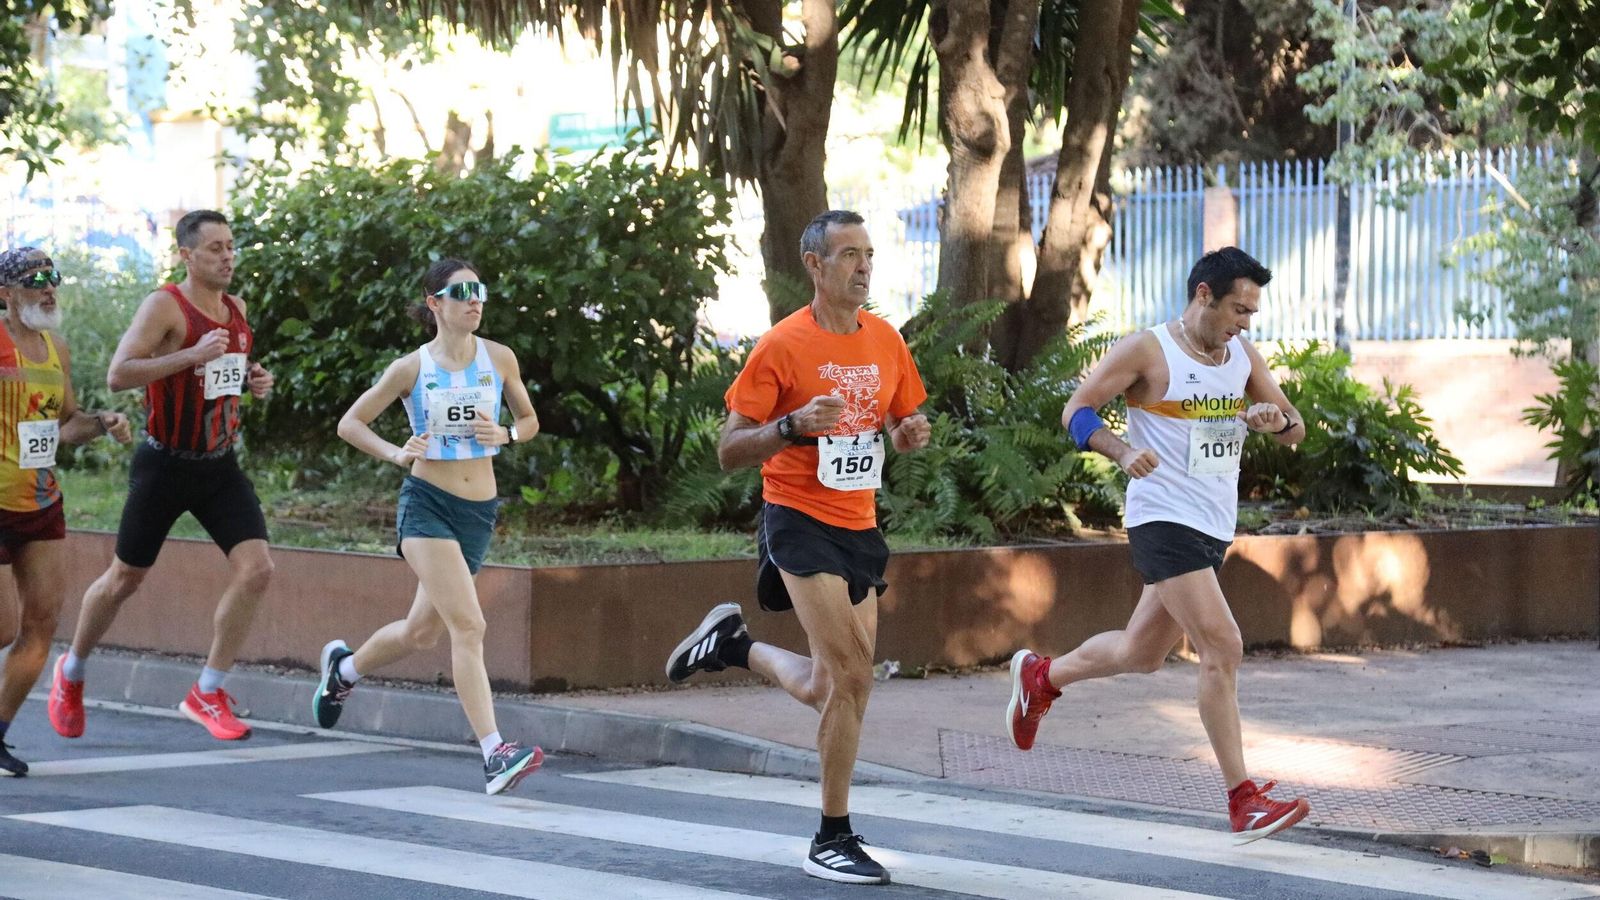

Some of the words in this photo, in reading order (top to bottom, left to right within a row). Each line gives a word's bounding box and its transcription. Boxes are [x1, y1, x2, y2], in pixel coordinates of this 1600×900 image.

[212, 368, 241, 385] 755
[1181, 392, 1245, 412] eMotio
[447, 405, 476, 421] 65
[1199, 411, 1236, 424] running
[1199, 440, 1240, 458] 1013
[830, 455, 874, 475] 150
